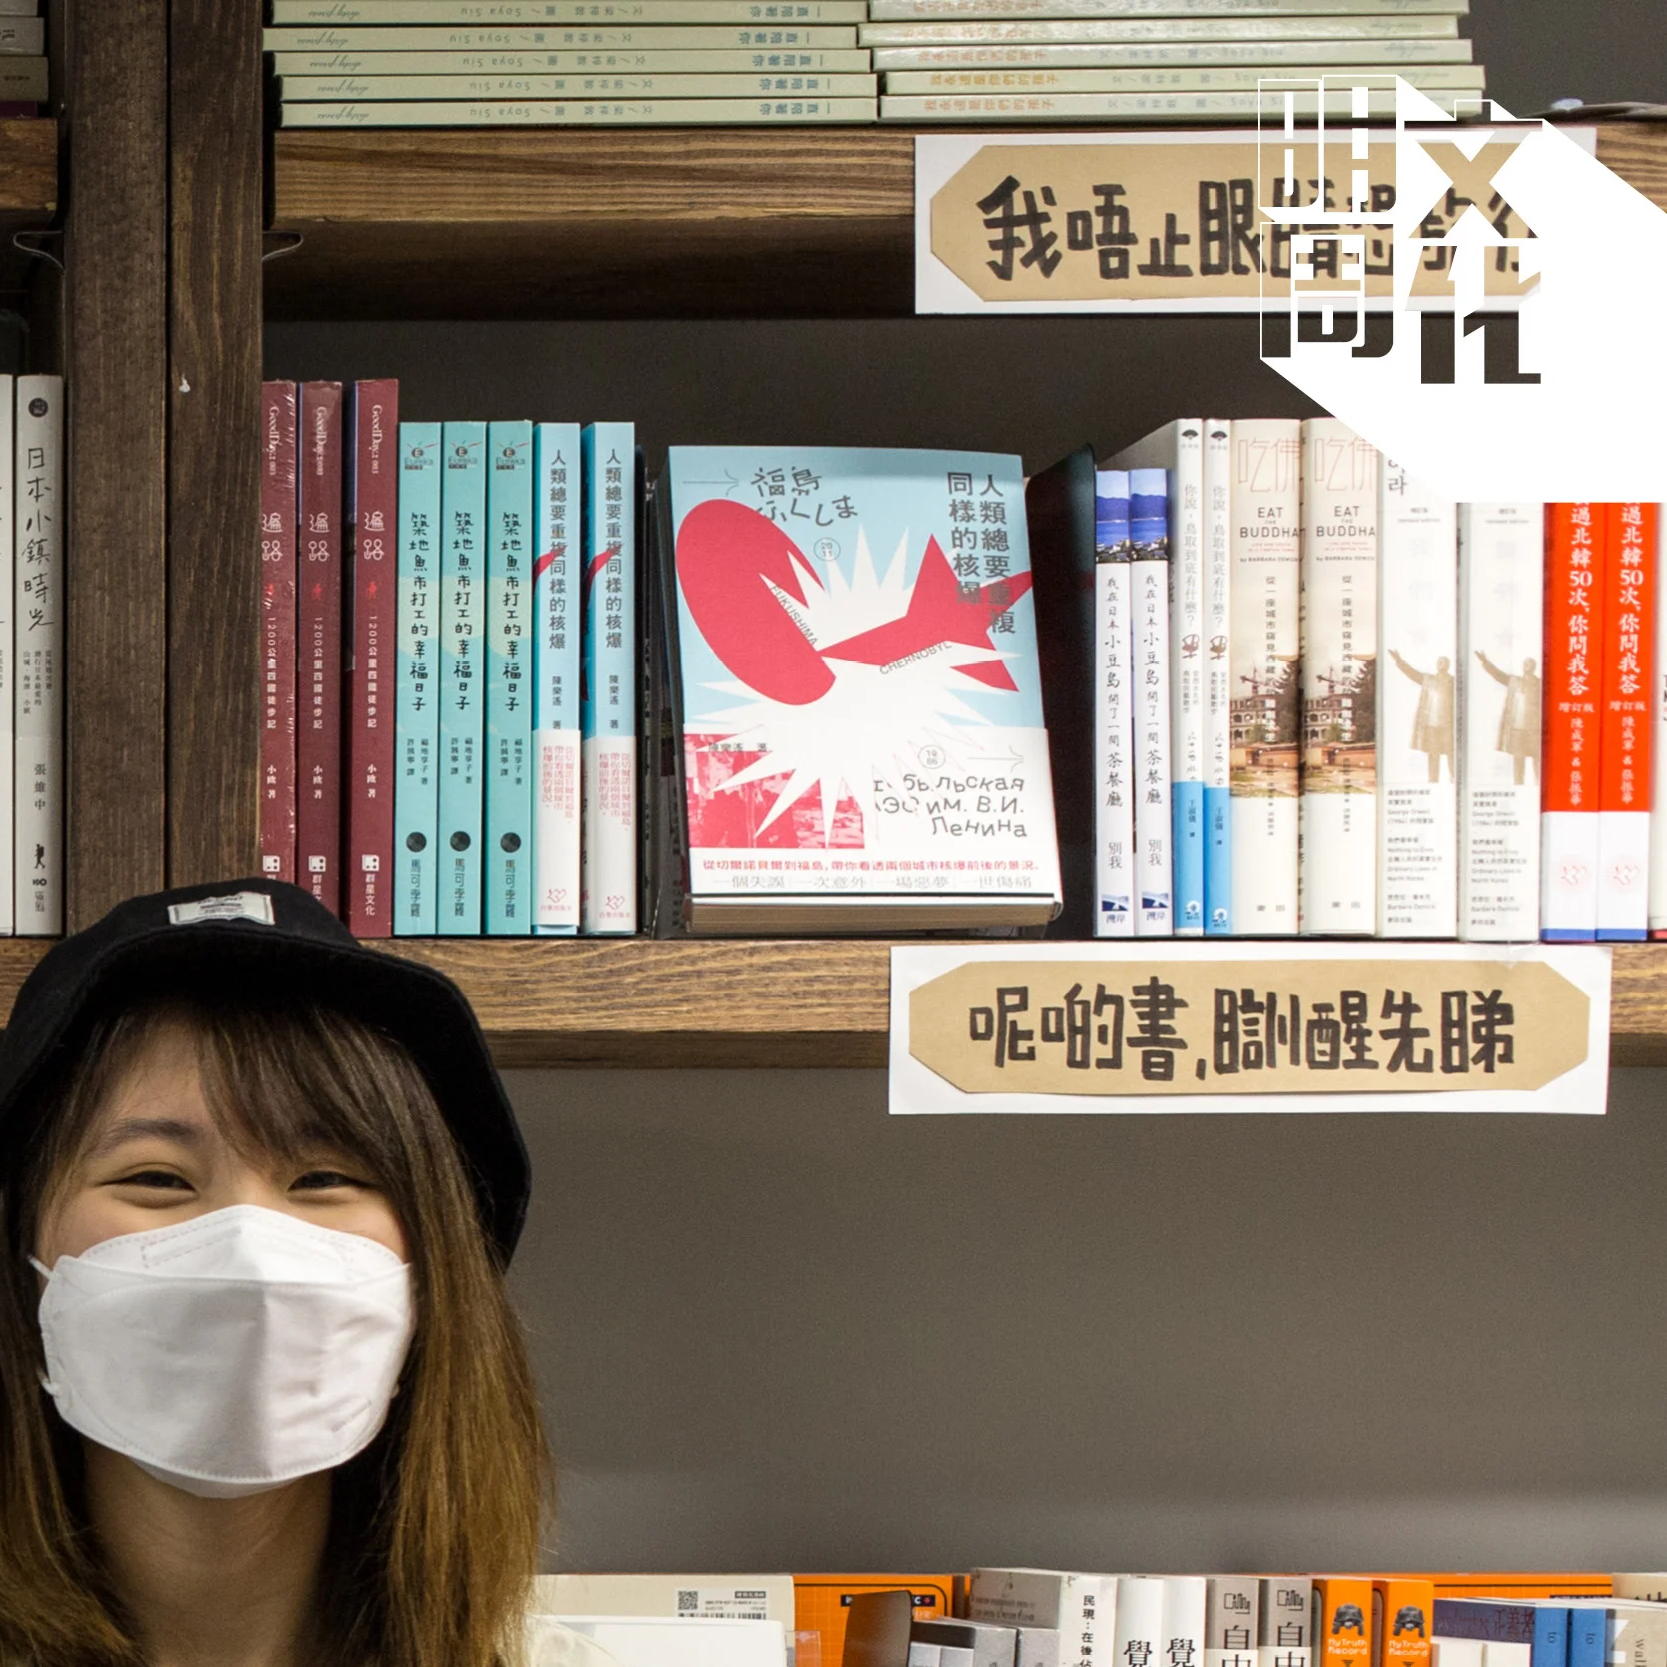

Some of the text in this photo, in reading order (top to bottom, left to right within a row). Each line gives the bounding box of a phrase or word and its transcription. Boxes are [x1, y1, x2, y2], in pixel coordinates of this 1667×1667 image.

[1256, 507, 1283, 518] EAT
[455, 512, 472, 710] 築地魚市打工的幸福日子
